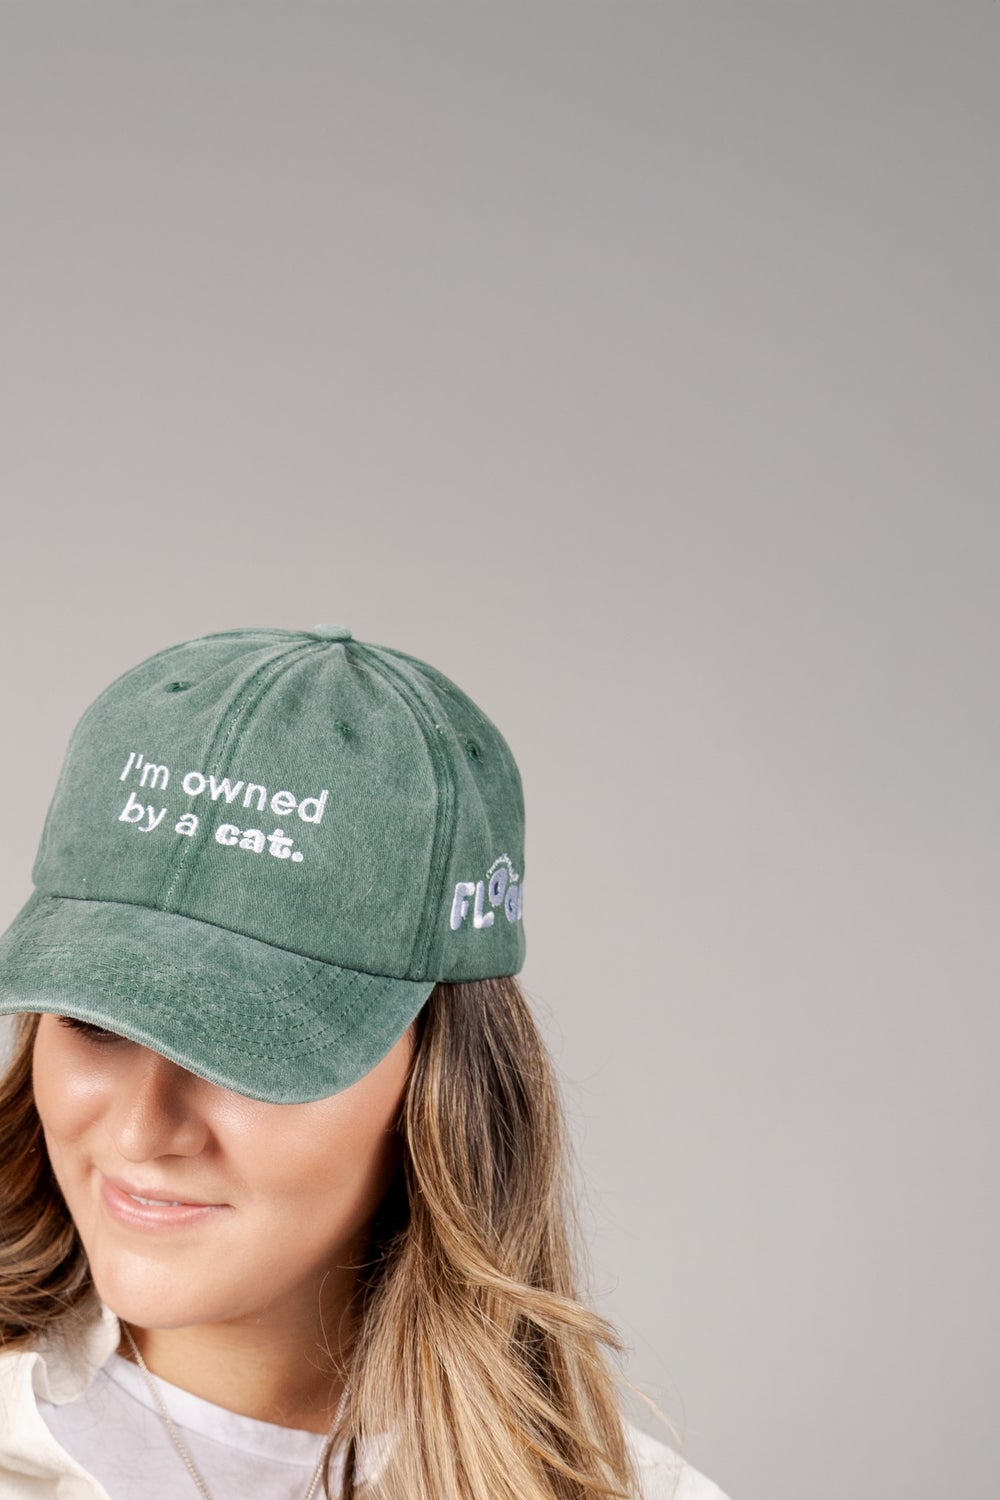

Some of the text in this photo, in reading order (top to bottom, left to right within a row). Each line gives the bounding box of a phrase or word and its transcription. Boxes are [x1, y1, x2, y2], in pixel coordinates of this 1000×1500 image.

[119, 751, 329, 824] I'm owned
[118, 791, 304, 863] by a cat.
[449, 867, 523, 931] FLOO
